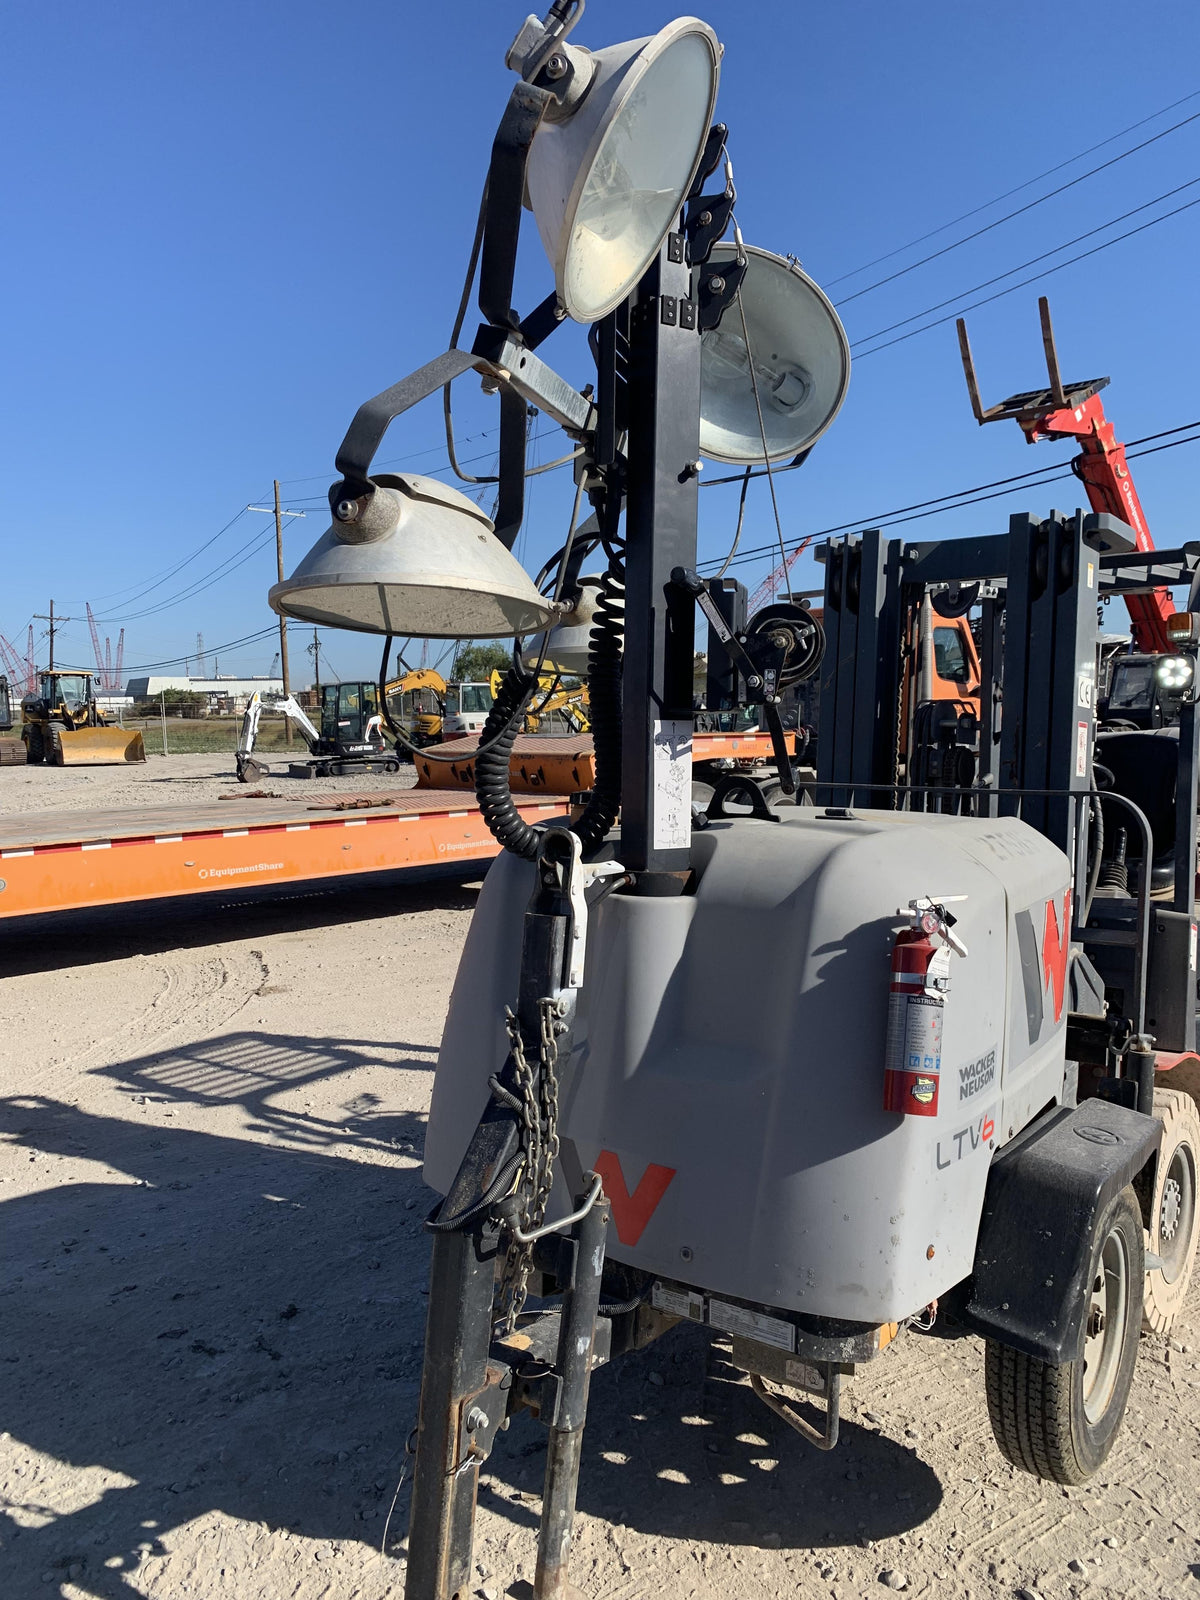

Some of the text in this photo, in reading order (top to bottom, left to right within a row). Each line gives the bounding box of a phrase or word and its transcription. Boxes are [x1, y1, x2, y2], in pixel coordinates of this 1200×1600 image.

[209, 862, 284, 877] EquipmentShare
[959, 1050, 995, 1083] WACKER
[960, 1065, 995, 1101] NEUSON
[937, 1113, 995, 1171] LTV6
